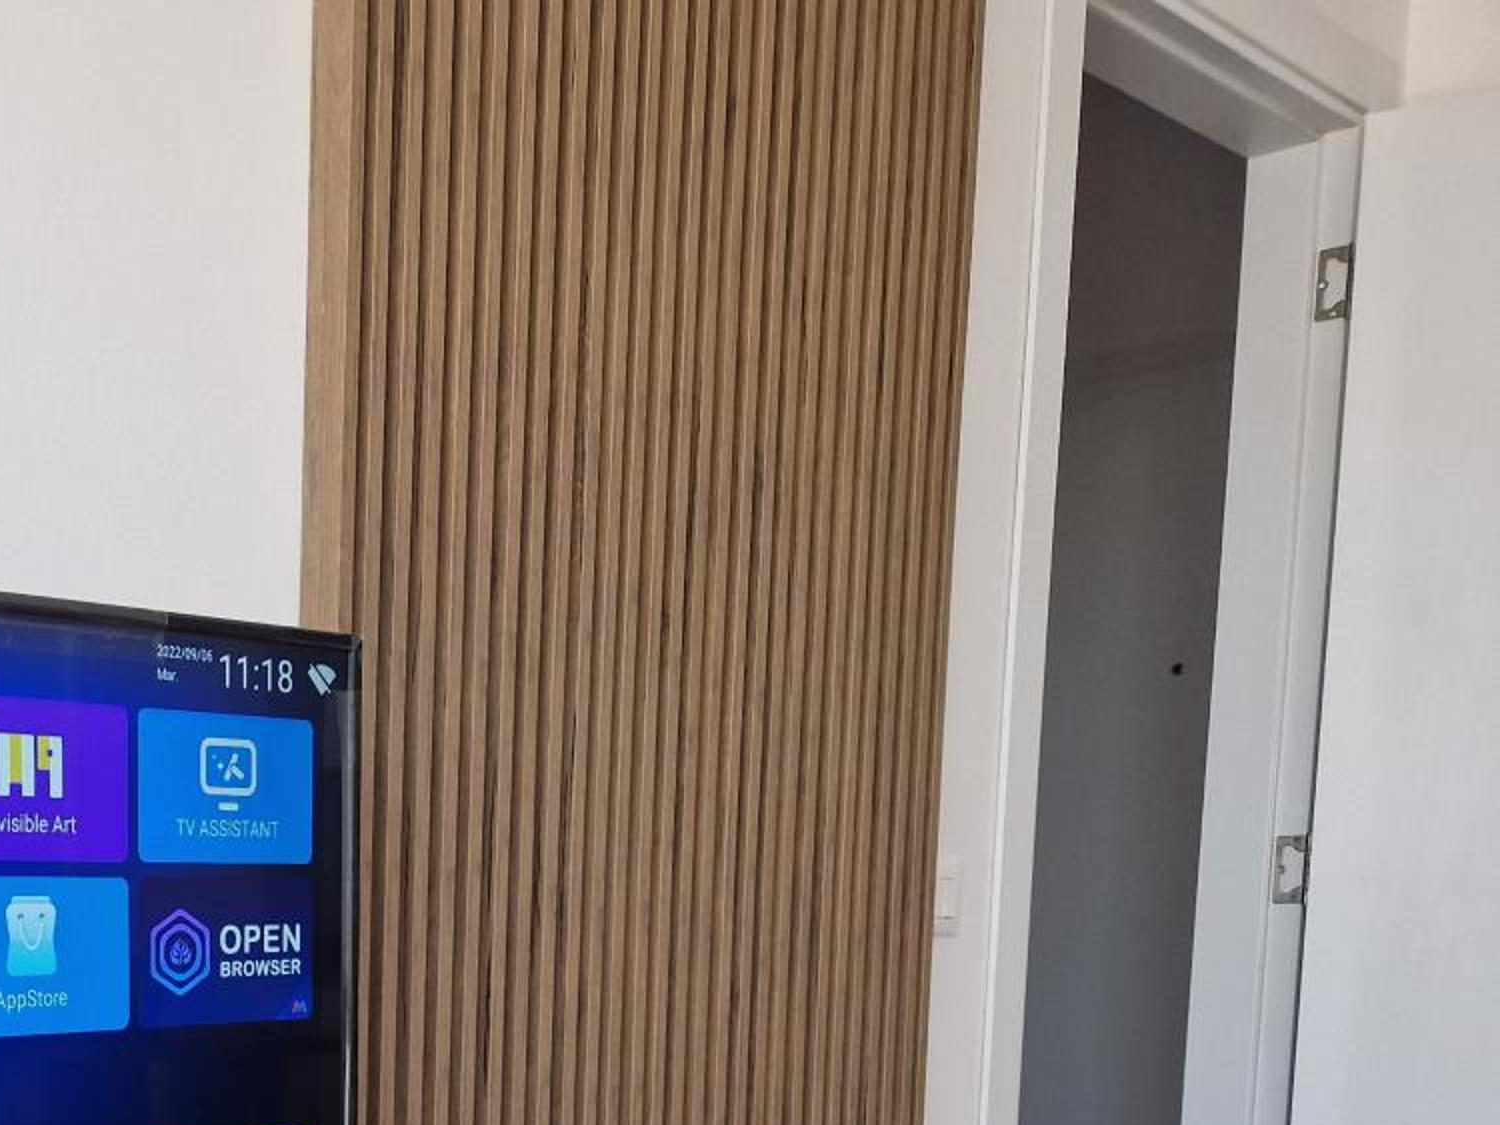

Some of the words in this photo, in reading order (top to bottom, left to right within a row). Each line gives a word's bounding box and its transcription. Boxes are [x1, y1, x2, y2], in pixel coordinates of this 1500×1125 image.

[219, 654, 293, 693] 11:18
[52, 815, 77, 834] Art
[176, 818, 195, 836] TV
[199, 820, 280, 838] ASSISTANT
[219, 924, 301, 954] OPEN
[219, 959, 302, 978] BROWSER
